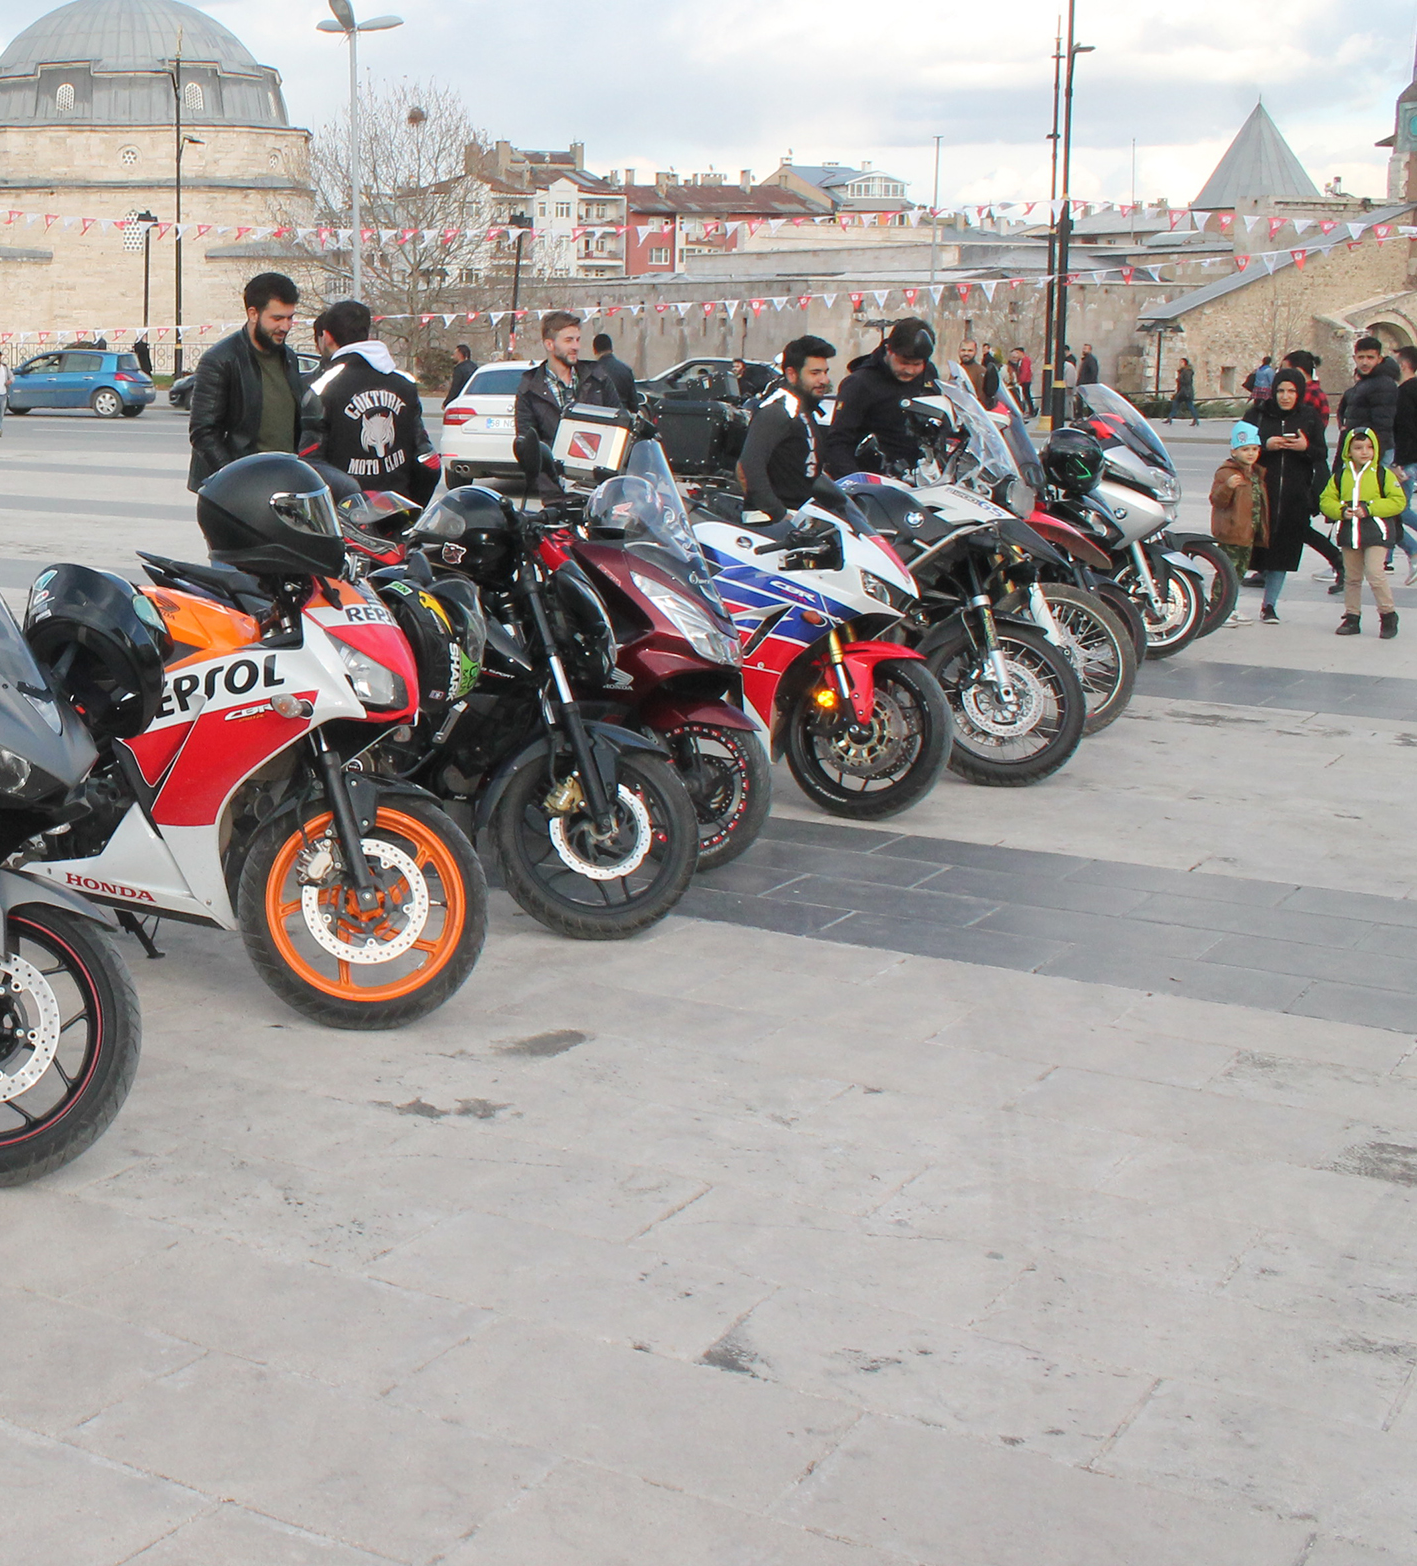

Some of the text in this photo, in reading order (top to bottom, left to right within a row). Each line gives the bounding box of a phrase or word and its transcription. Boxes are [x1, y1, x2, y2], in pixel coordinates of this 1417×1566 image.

[347, 449, 406, 476] MOTO CLUB
[155, 653, 285, 719] EPSOL
[446, 642, 462, 702] SHARK
[65, 872, 157, 903] HONDA
